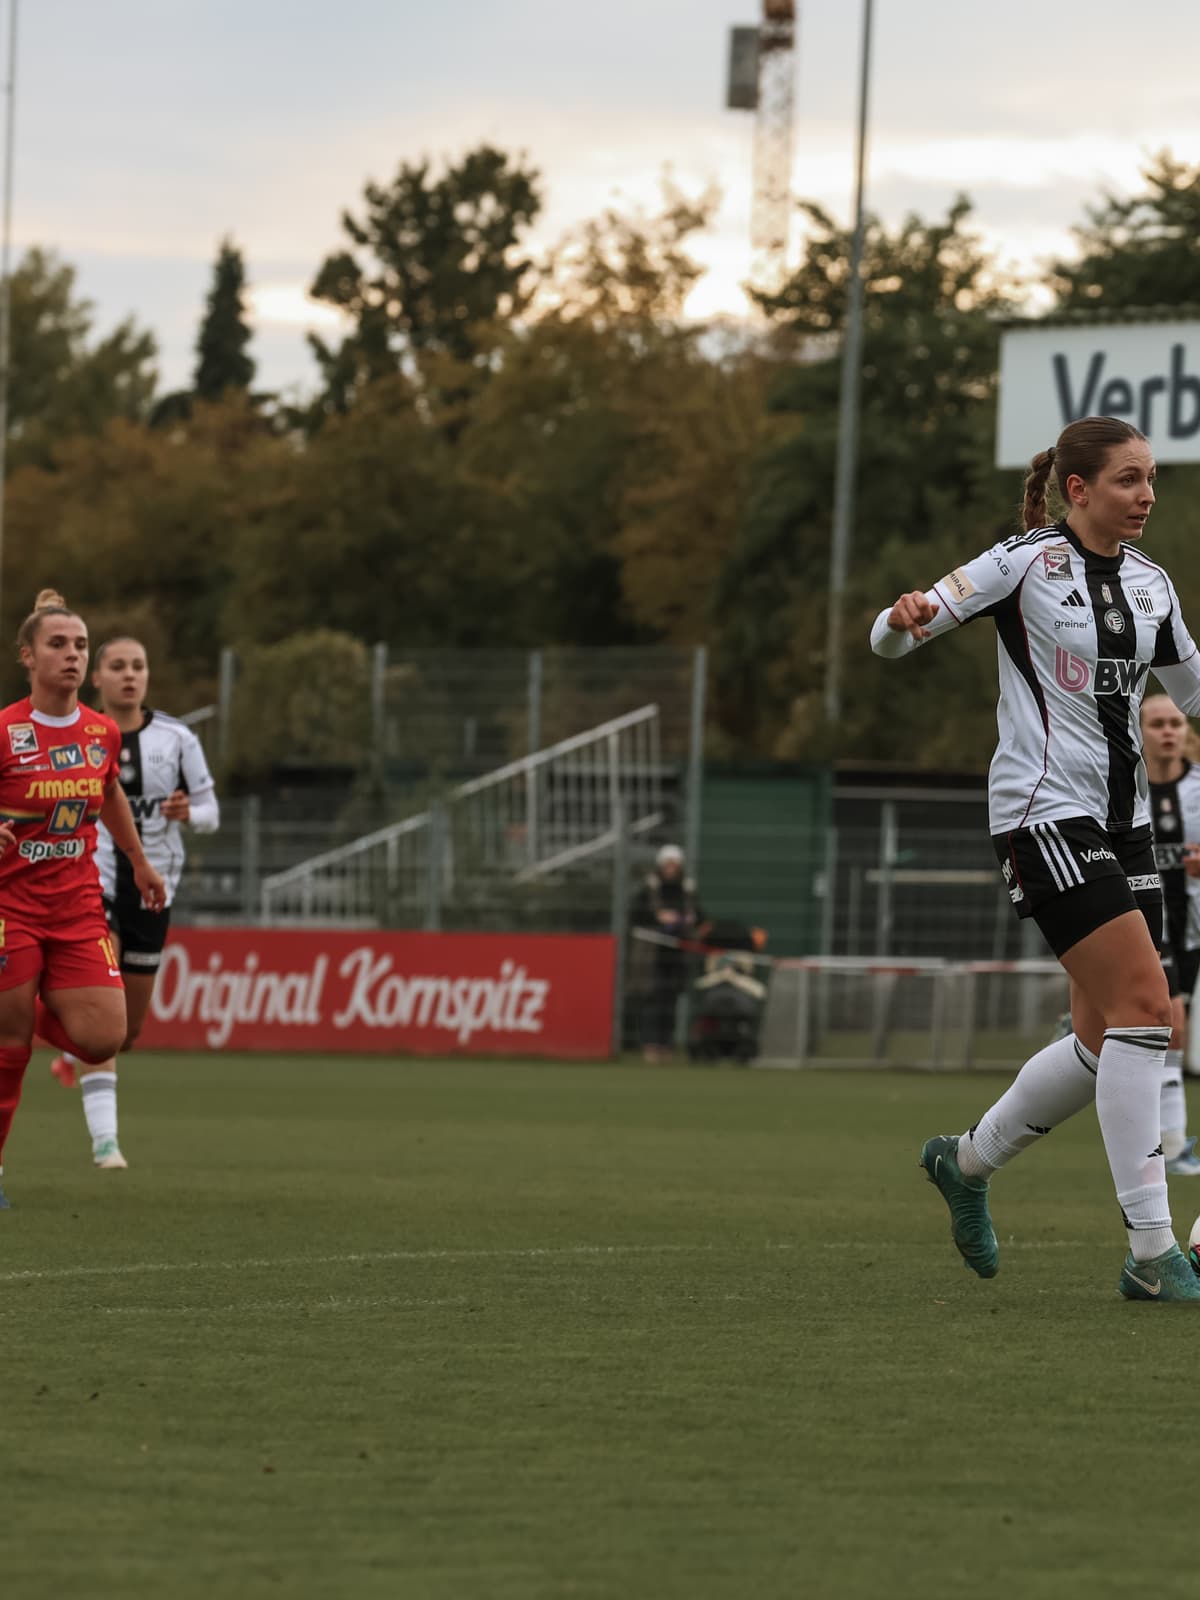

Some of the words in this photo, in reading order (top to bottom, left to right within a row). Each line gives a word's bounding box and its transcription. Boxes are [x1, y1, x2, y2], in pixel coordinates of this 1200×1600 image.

[1054, 619, 1088, 630] greiner
[1094, 659, 1151, 696] BW
[151, 943, 329, 1047] Original
[333, 945, 549, 1046] Kornspitz
